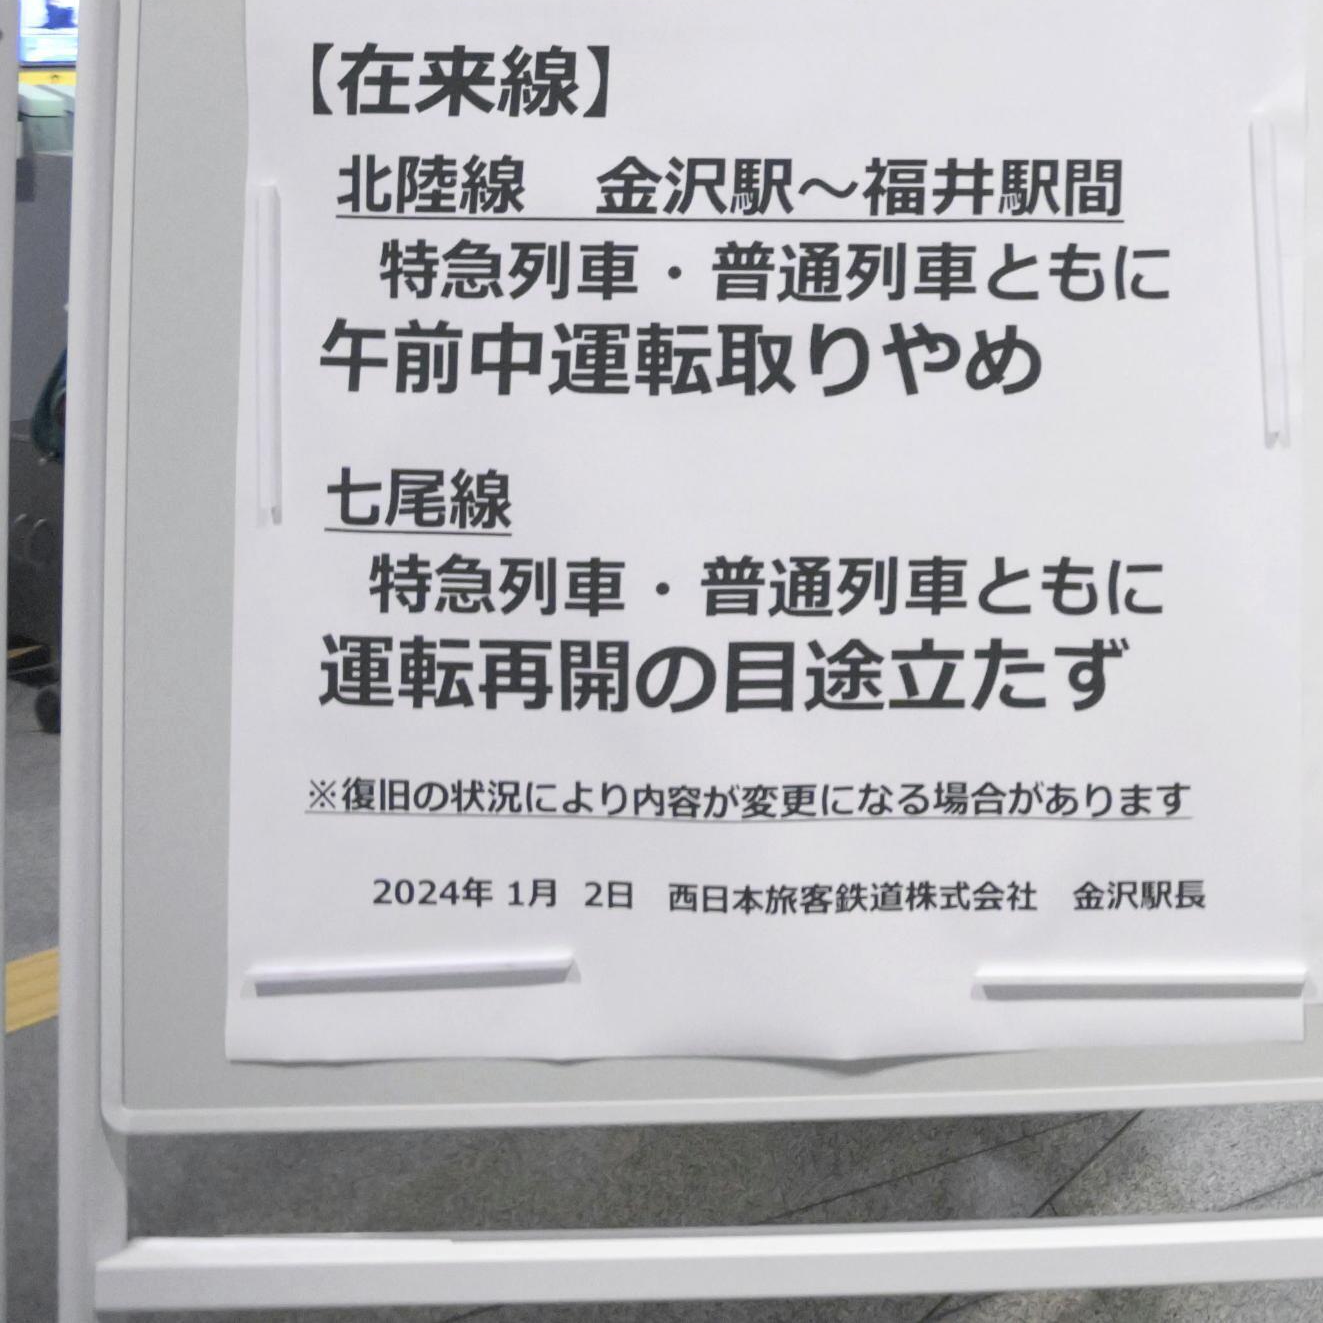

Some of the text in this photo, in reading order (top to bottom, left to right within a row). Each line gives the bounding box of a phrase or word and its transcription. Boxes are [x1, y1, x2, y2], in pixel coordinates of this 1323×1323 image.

[312, 42, 610, 118] 【在来線】
[336, 154, 1124, 217] 北陸線 金沢駅~福井駅間
[379, 238, 1171, 303] 特急列車・普通列車ともに
[319, 317, 1042, 398] 午前中運転取りやめ
[326, 466, 512, 529] 七尾線
[368, 552, 1164, 618] 特急列車・普通列車ともに
[318, 633, 1130, 714] 運転再開の目途立たず
[307, 776, 1192, 819] ※復旧の状況により内容が変更になる場合があります
[372, 876, 1206, 916] 2024年 1月 2日 西日本旅客鉄道株式会社 金沢駅長
